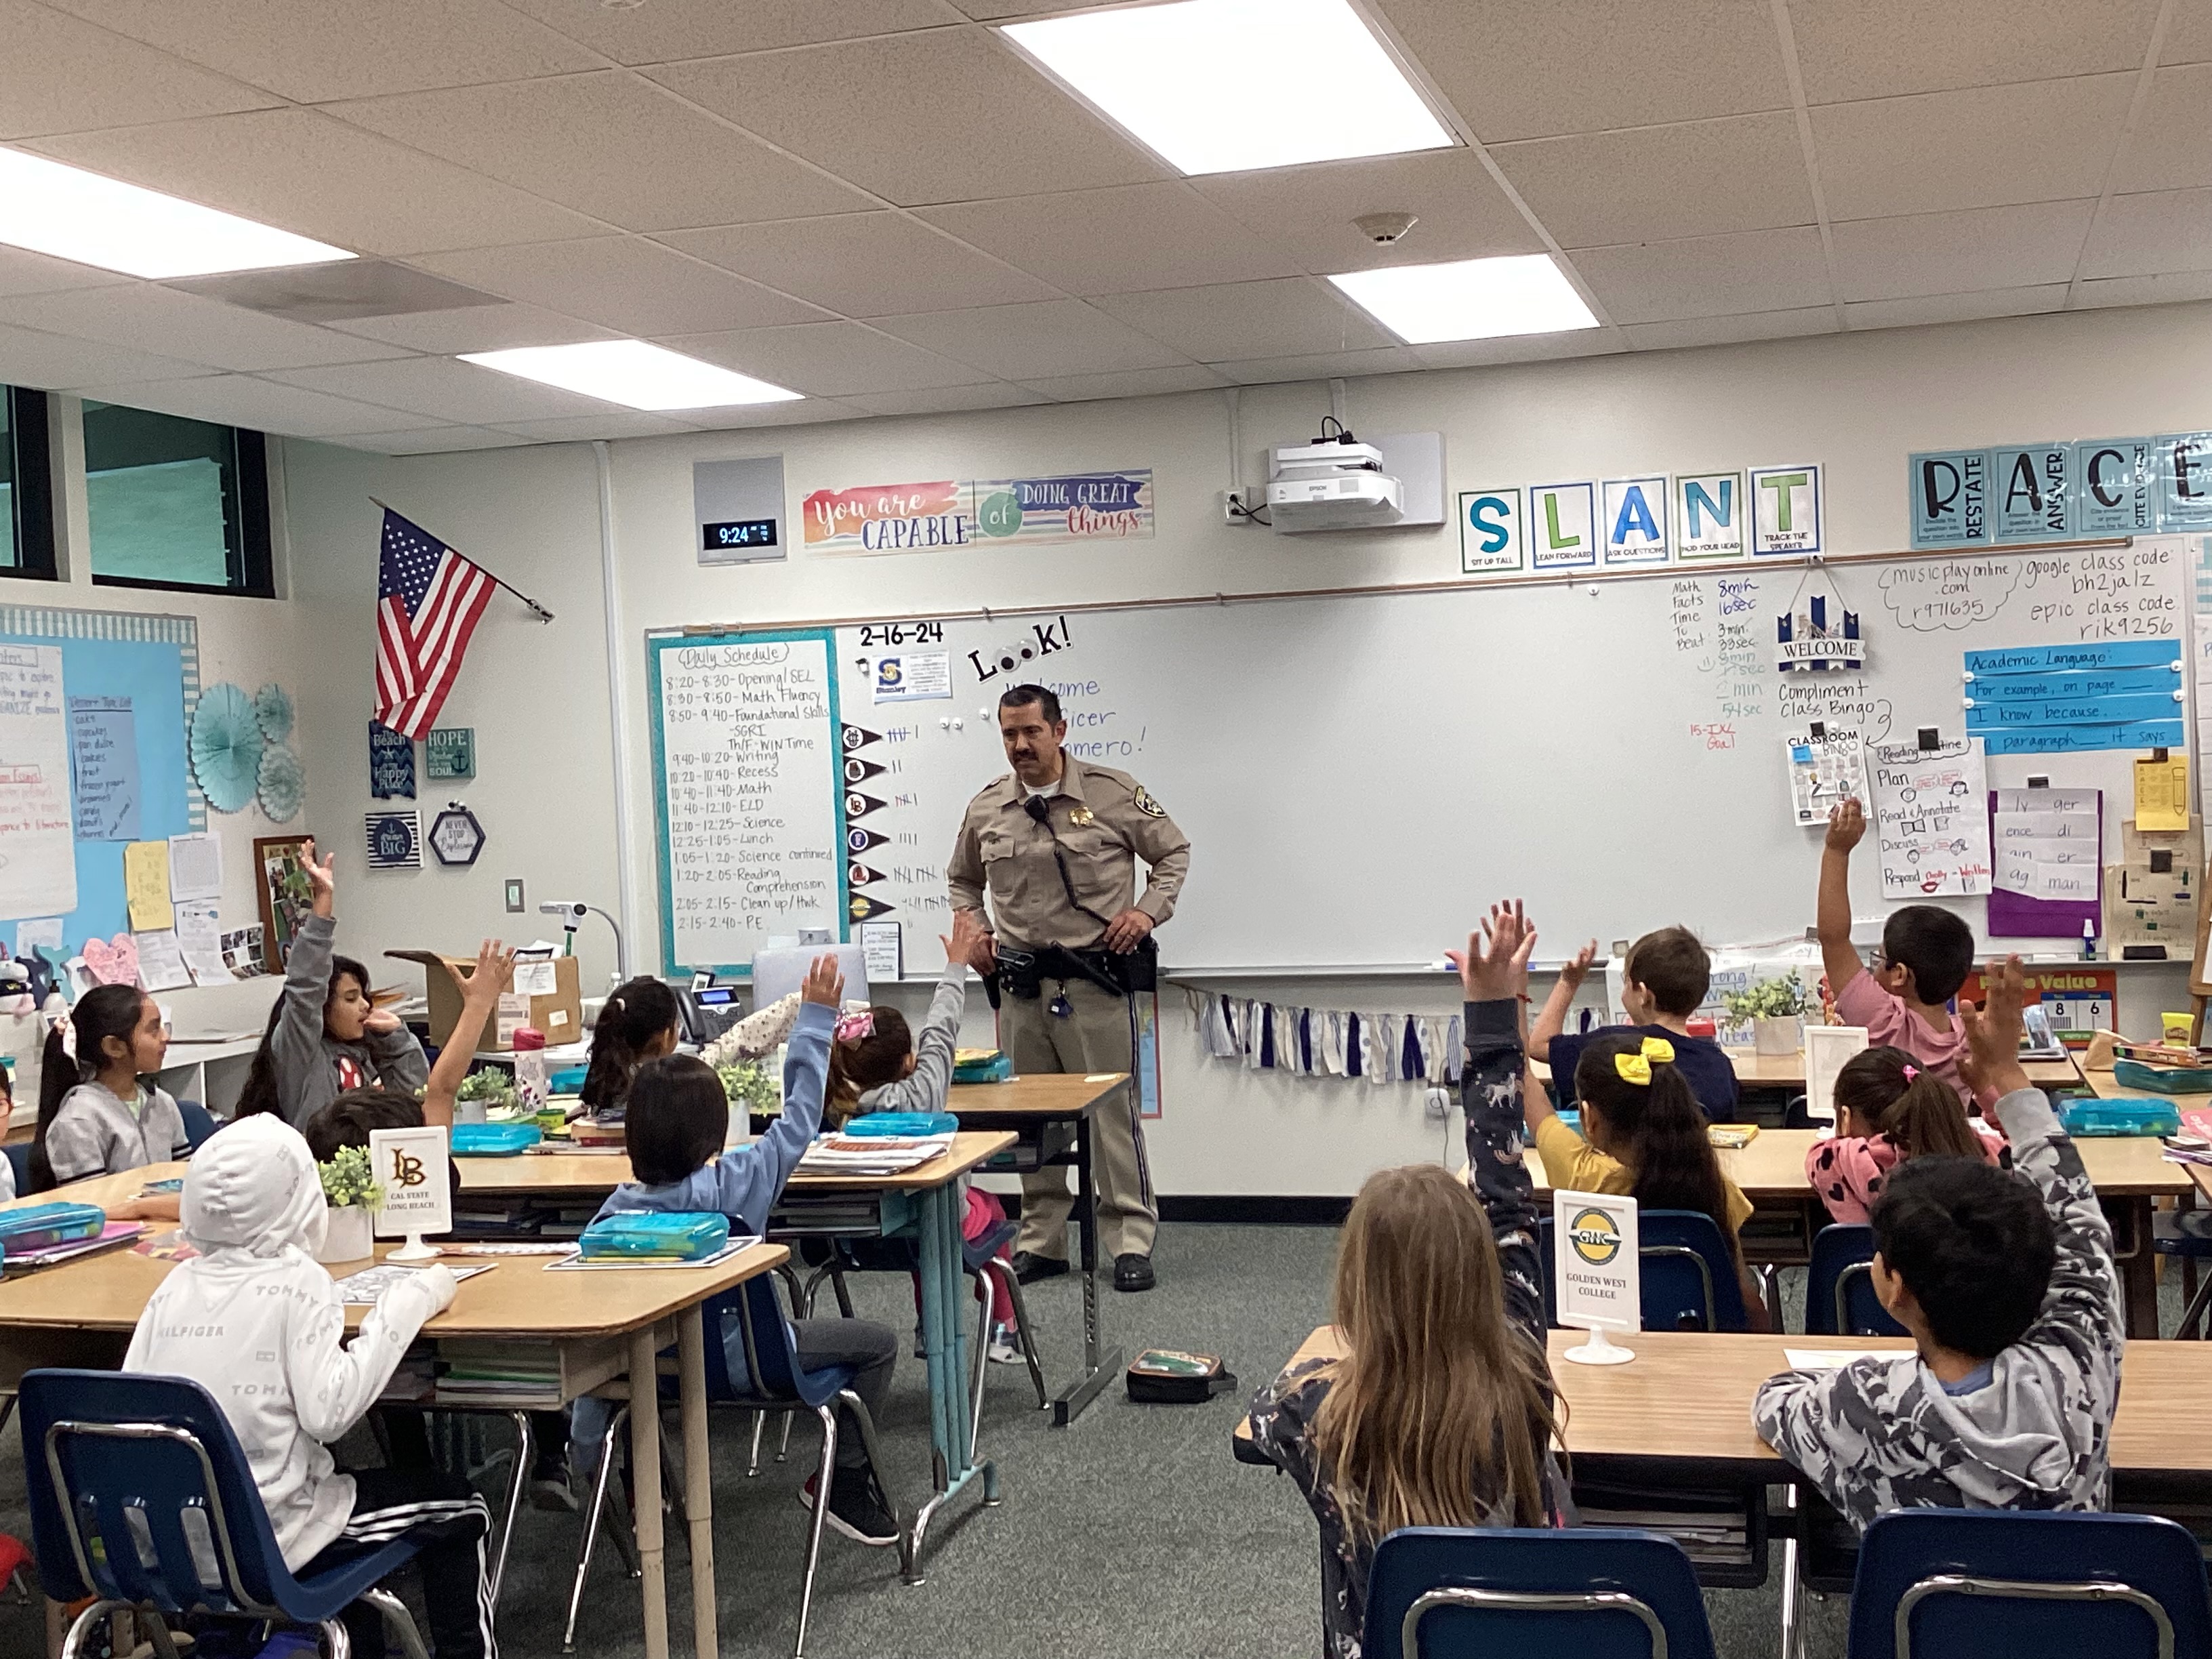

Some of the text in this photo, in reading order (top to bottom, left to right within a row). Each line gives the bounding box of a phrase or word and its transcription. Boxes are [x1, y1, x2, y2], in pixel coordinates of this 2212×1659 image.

[1022, 481, 1131, 506] DOING GREAT
[1965, 456, 1983, 539] RESTATE
[2047, 451, 2065, 531] ANSWER
[814, 492, 926, 536] You are
[989, 504, 1010, 526] of
[1067, 506, 1141, 535] things
[2135, 502, 2146, 527] CITE
[720, 527, 748, 544] 9:24
[861, 514, 970, 551] CAPABLE
[1765, 533, 1788, 542] TRACK
[2025, 557, 2070, 589] google
[2081, 552, 2125, 571] class
[1913, 598, 1984, 619] r971635
[2031, 600, 2074, 623] epic
[2088, 598, 2129, 615] class
[1669, 611, 1701, 626] Time
[860, 621, 944, 647] 2-16-24
[2080, 616, 2173, 640] rik9256
[687, 645, 779, 668] Daily Schedule
[1784, 642, 1858, 658] WELCOME
[1972, 651, 2038, 671] Academic
[1779, 679, 1869, 703] Compliment
[1975, 681, 1996, 697] For
[2064, 680, 2078, 692] on
[2087, 680, 2115, 695] page
[742, 689, 775, 704] Math
[780, 688, 821, 707] Fluency
[1781, 700, 1875, 724] Class Bingo
[2000, 707, 2033, 722] know
[373, 733, 406, 746] Beach
[428, 731, 467, 746] HOPE
[785, 737, 815, 750] Time
[1064, 726, 1147, 757] omero!
[1788, 730, 1859, 746] CLASSROOM
[2003, 732, 2078, 752] paragraph
[2112, 727, 2127, 744] it
[736, 750, 779, 766] Writing
[1883, 746, 1919, 760] Reading
[375, 766, 409, 782] Happy
[429, 766, 455, 776] SOUL
[738, 766, 779, 779] Recess
[1877, 769, 1910, 787] Plan
[380, 779, 404, 790] Place
[737, 781, 772, 796] Math
[740, 799, 764, 813] ELD
[1880, 808, 1906, 823] Read
[1916, 800, 1961, 819] Annotate
[445, 820, 468, 830] NEVER
[743, 817, 785, 829] Science
[449, 829, 465, 840] STOP
[740, 832, 773, 844] Lunch
[2006, 827, 2033, 837] ence
[381, 840, 406, 855] BIG
[1881, 838, 1919, 852] Discuss
[738, 851, 781, 863] Science
[2057, 852, 2076, 863] er
[737, 868, 781, 884] Reading
[1884, 868, 1921, 888] Respond
[2009, 868, 2080, 890] ag man
[746, 880, 827, 897] Comprehension
[741, 896, 771, 909] Clean
[2039, 974, 2098, 990] Value
[2055, 1002, 2100, 1016] 8 6
[407, 1191, 430, 1200] STATE
[387, 1201, 434, 1211] LONG BEACH
[1579, 1230, 1610, 1246] GWC
[1567, 1273, 1626, 1288] GOLDEN WEST
[1578, 1286, 1617, 1300] COLLEGE
